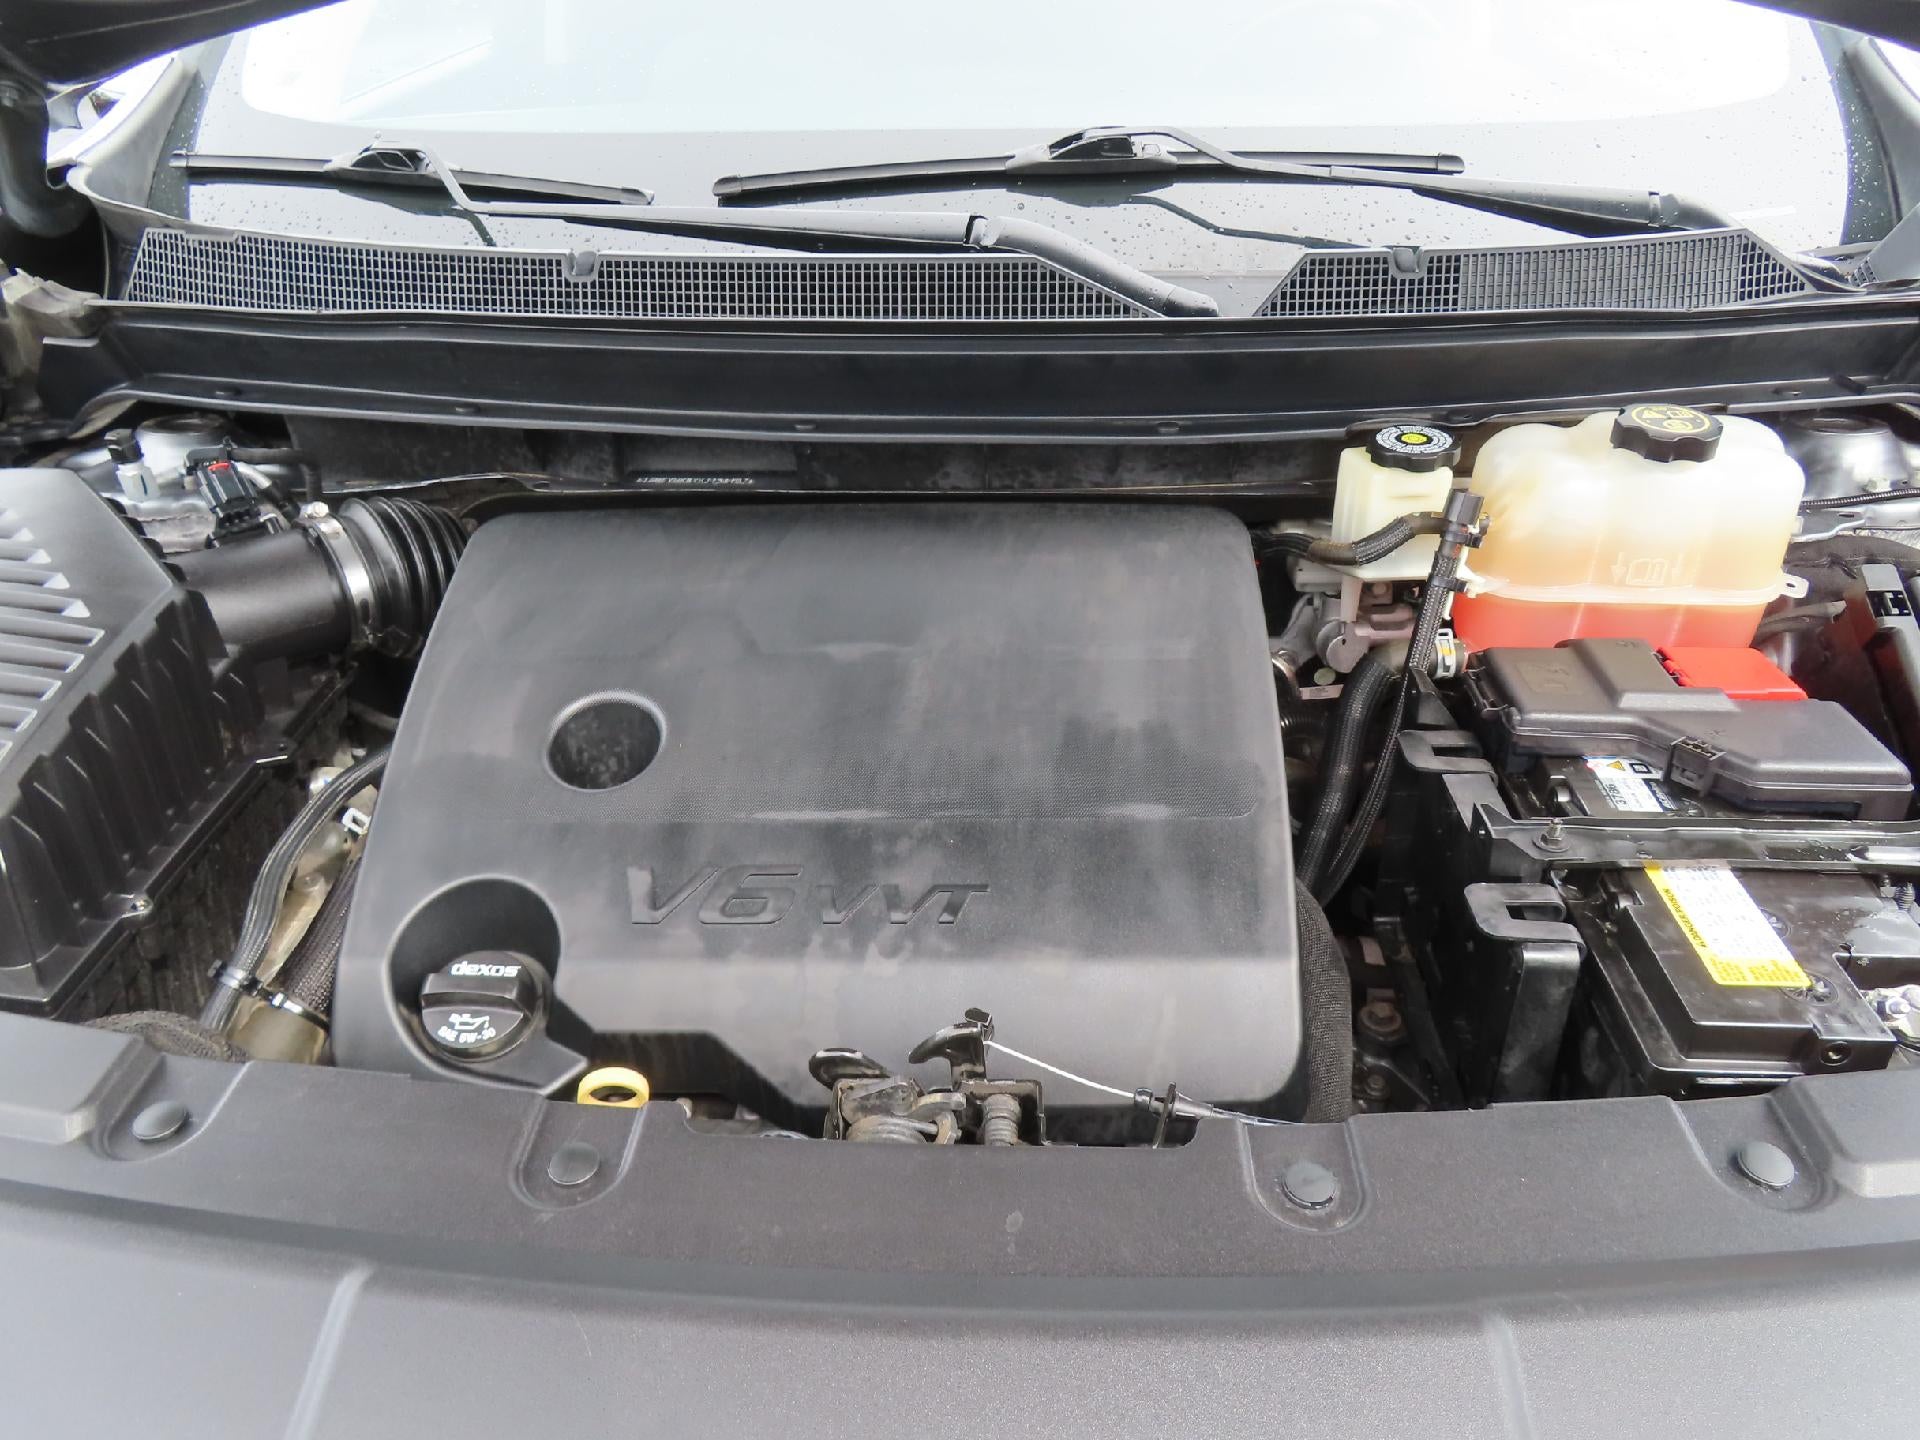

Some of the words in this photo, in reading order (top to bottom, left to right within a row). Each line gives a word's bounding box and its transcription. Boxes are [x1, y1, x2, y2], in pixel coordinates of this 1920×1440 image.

[626, 865, 802, 924] V6
[816, 884, 990, 924] VVT
[451, 961, 521, 977] dexos
